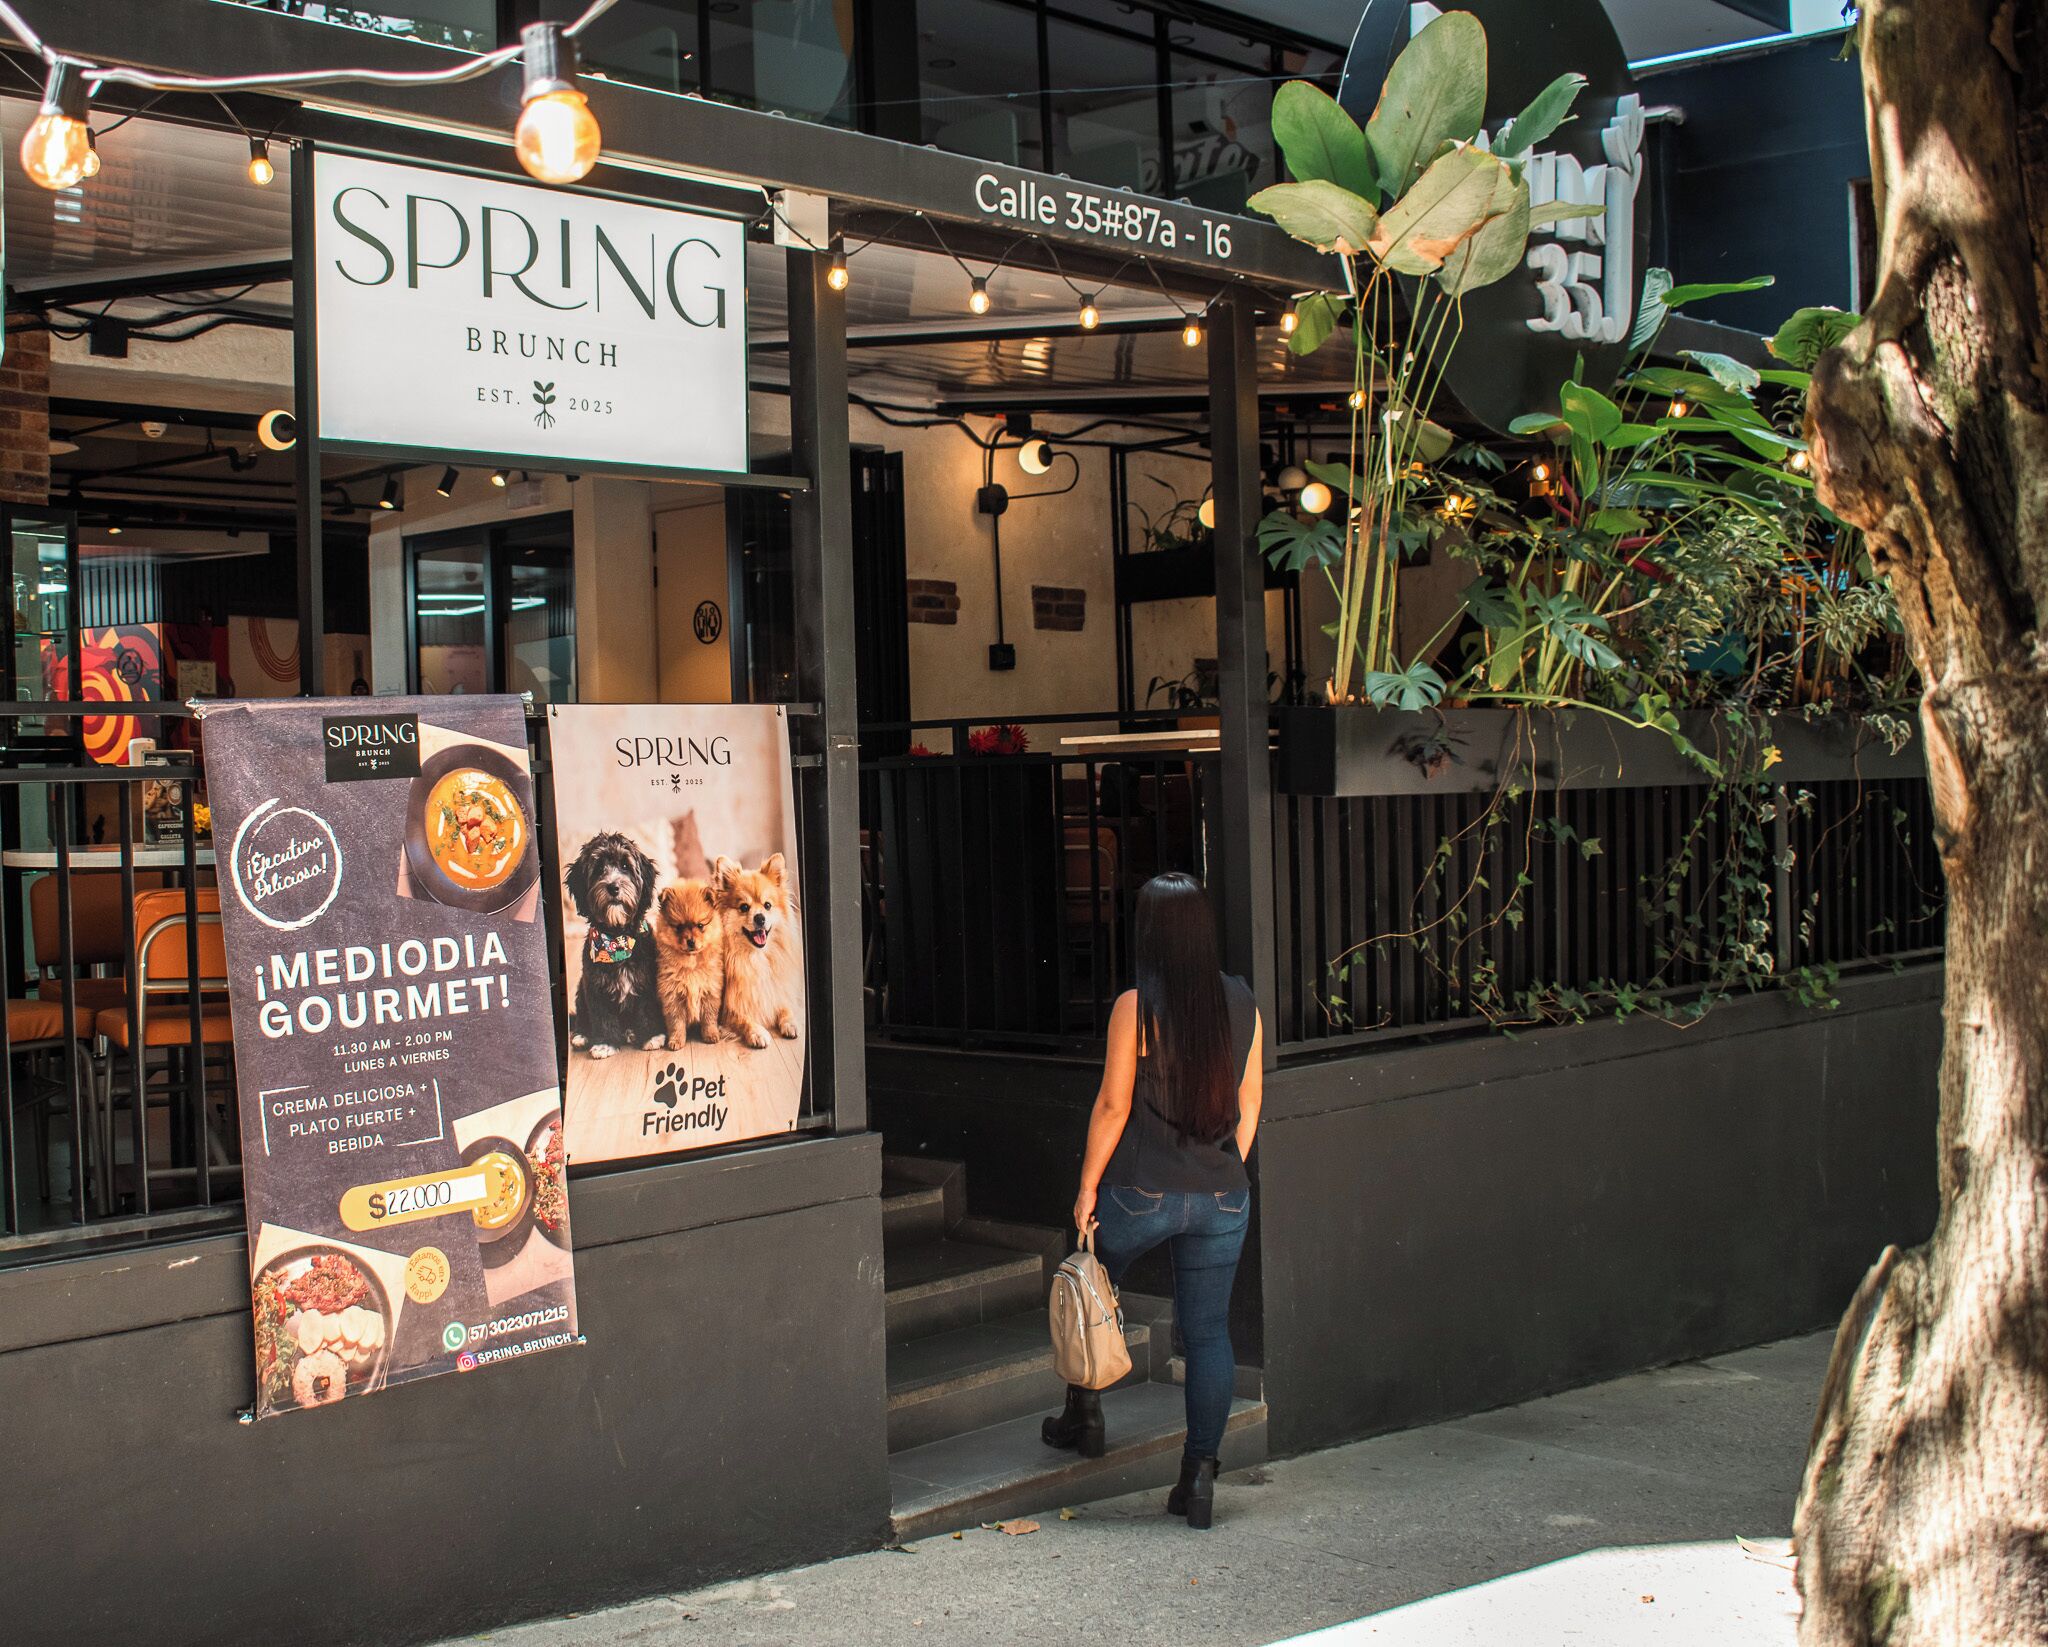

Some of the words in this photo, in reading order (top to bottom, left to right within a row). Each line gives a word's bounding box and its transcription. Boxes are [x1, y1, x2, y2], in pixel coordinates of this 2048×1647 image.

[975, 174, 1057, 224] Calle
[1065, 191, 1176, 248] 35#87a
[1202, 219, 1232, 258] 16
[333, 187, 726, 329] SPRING
[466, 327, 617, 367] BRUNCH
[477, 387, 520, 405] EST.
[569, 397, 613, 414] 2025
[327, 723, 416, 748] SPRING
[355, 748, 391, 757] BRUNCH
[616, 736, 731, 767] SPRING
[255, 931, 508, 1001] ¡MEDIODIA
[259, 974, 510, 1038] GOURMET!
[333, 1041, 367, 1056] 11.30
[372, 1038, 391, 1051] AM
[405, 1033, 431, 1047] 2.00
[435, 1029, 453, 1042] PM
[344, 1057, 385, 1073] LUNES
[389, 1056, 397, 1067] A
[401, 1048, 450, 1065] VIERNES
[272, 1097, 328, 1116] CREMA
[333, 1083, 415, 1107] DELICIOSA
[691, 1074, 726, 1101] Pet
[290, 1118, 340, 1137] PLATO
[345, 1107, 403, 1128] FUERTE
[642, 1103, 728, 1136] Friendly
[328, 1133, 384, 1154] BEBIDA
[368, 1181, 451, 1222] $22.000
[467, 1322, 488, 1343] (57)
[489, 1305, 568, 1336] 3023071215
[477, 1333, 572, 1363] SPRING.BRUNCH
